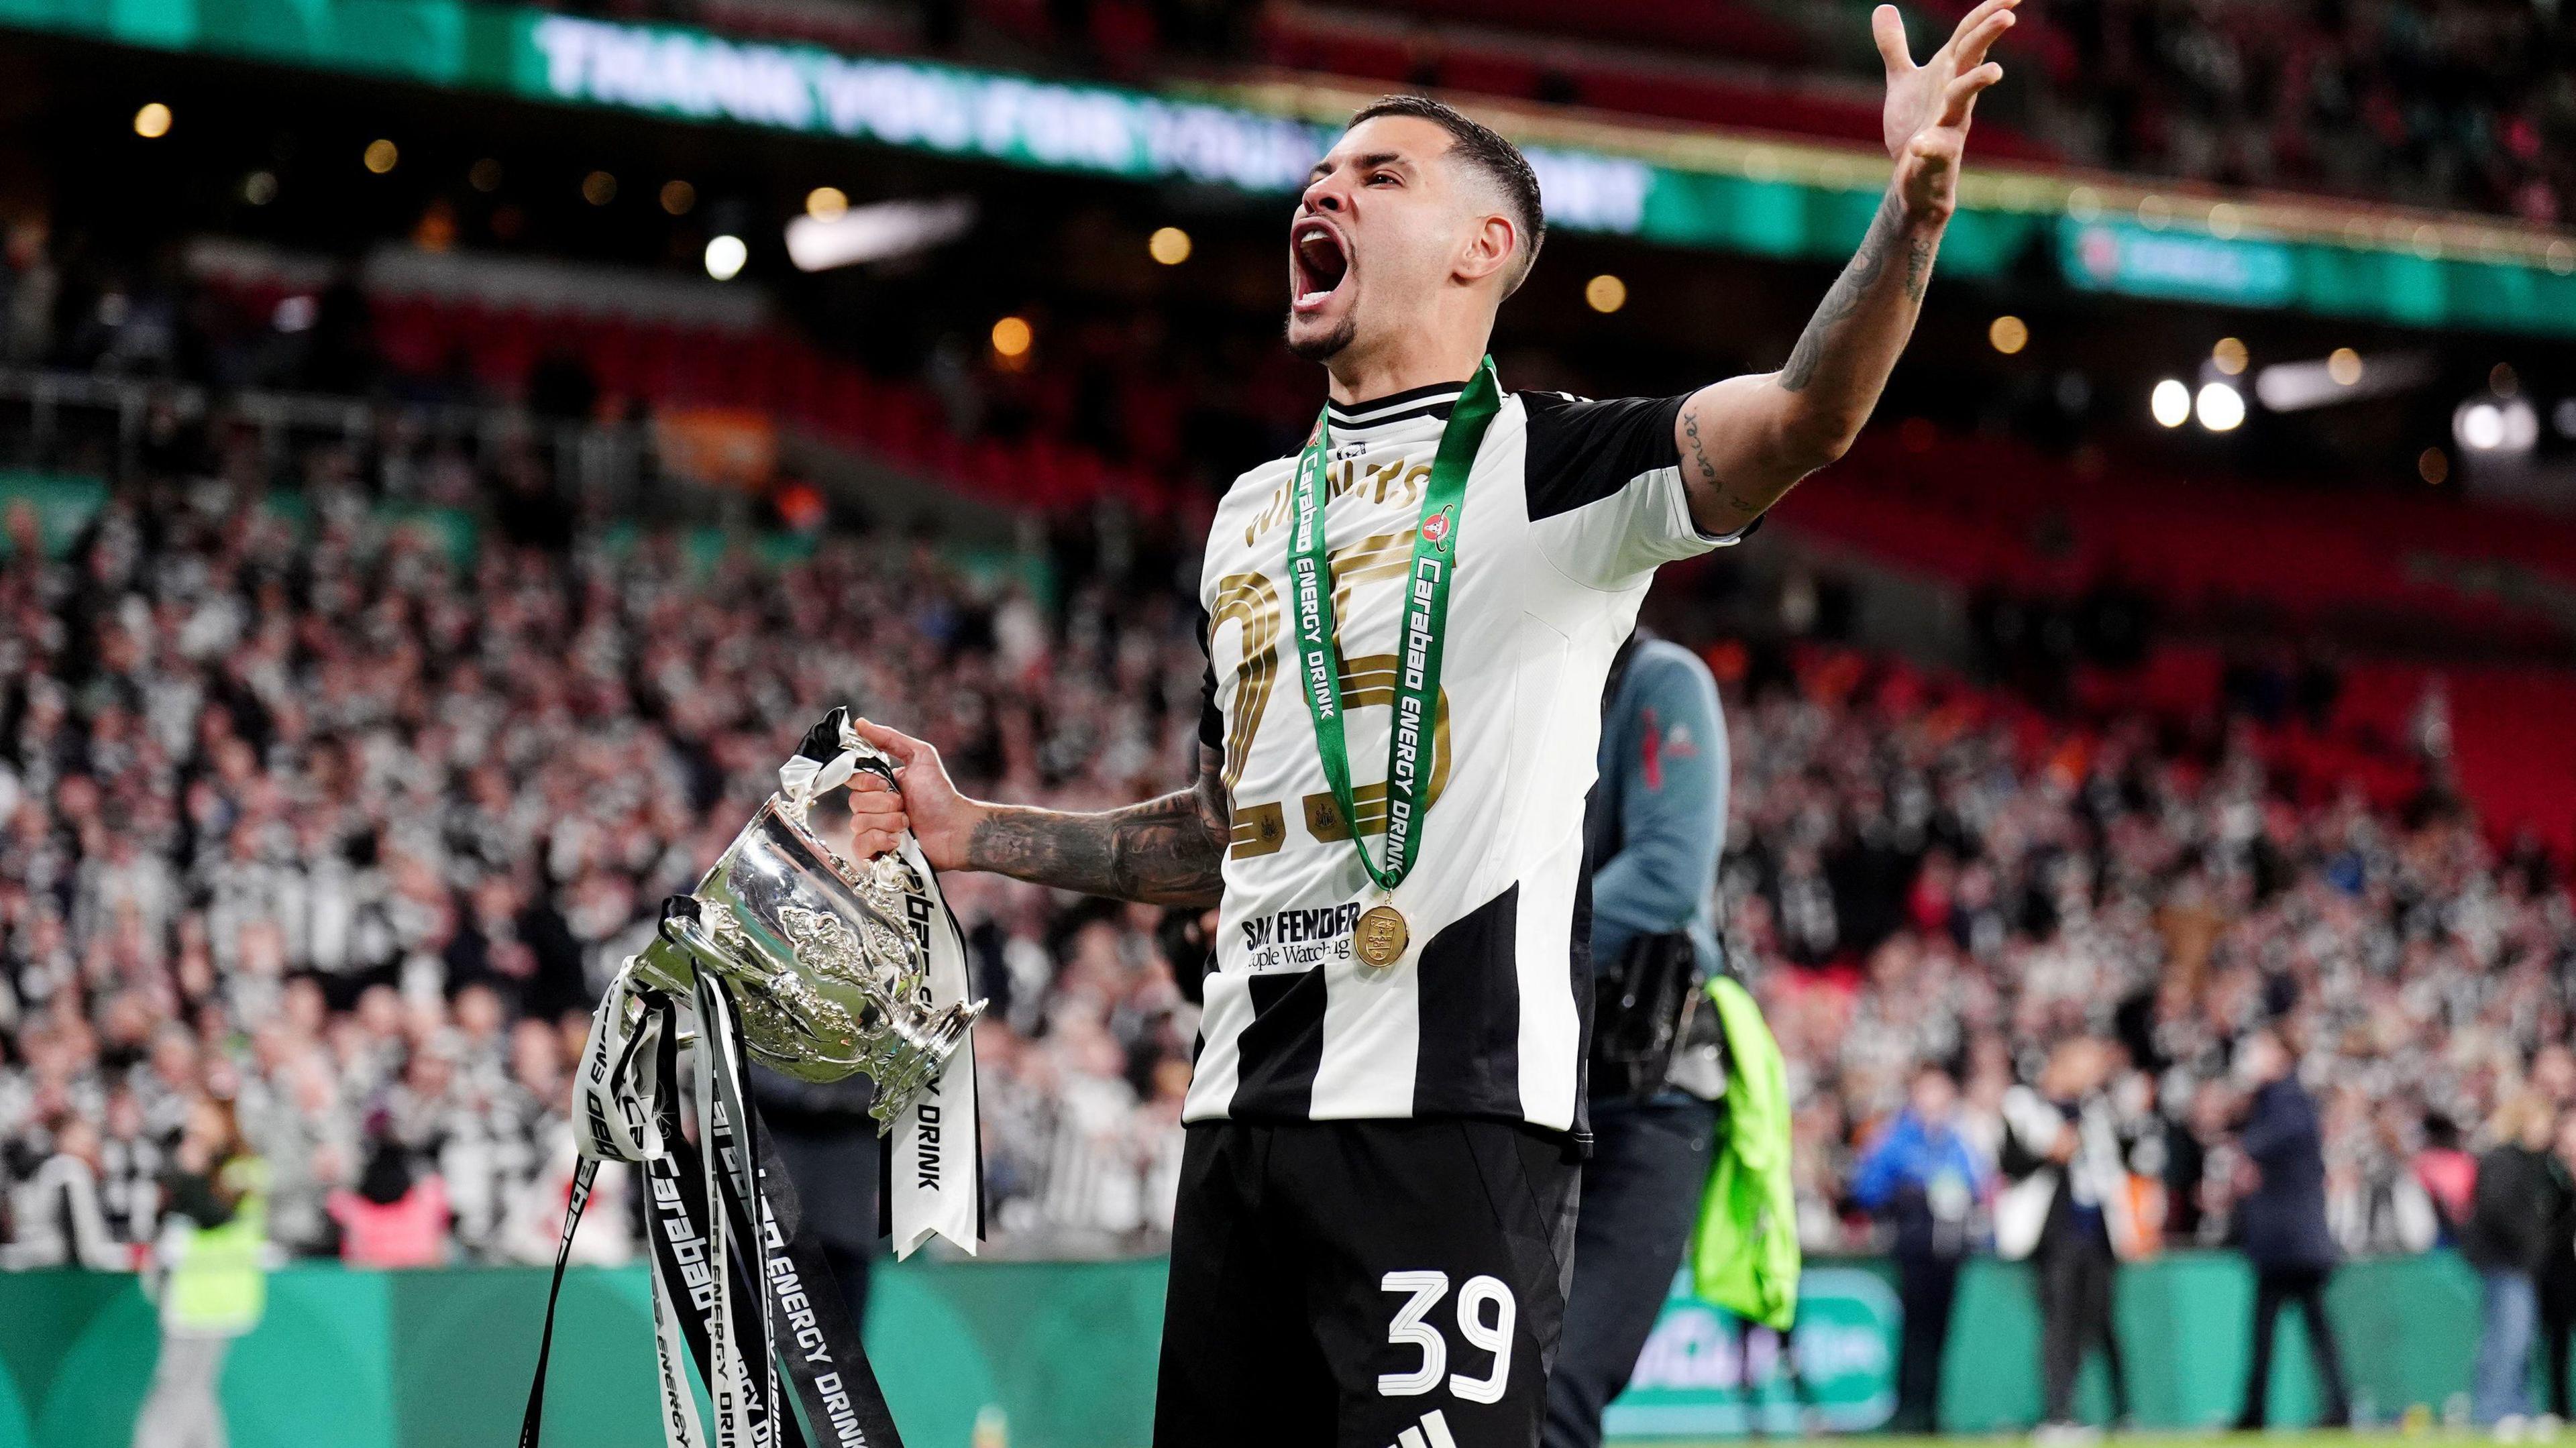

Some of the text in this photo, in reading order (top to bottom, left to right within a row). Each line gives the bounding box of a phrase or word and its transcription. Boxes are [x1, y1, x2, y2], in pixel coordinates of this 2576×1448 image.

[1295, 451, 1334, 720] Carabao ENERGY DRINK
[1387, 556, 1442, 876] Carabao ENERGY DRINK
[1248, 946, 1279, 971] ople
[1277, 901, 1360, 944] FENDER
[918, 1104, 940, 1191] DRINK
[712, 1265, 729, 1381] ENERGY
[769, 1256, 833, 1363] ENERGY
[1377, 1270, 1516, 1404] 39
[657, 1335, 691, 1448] ENERGY
